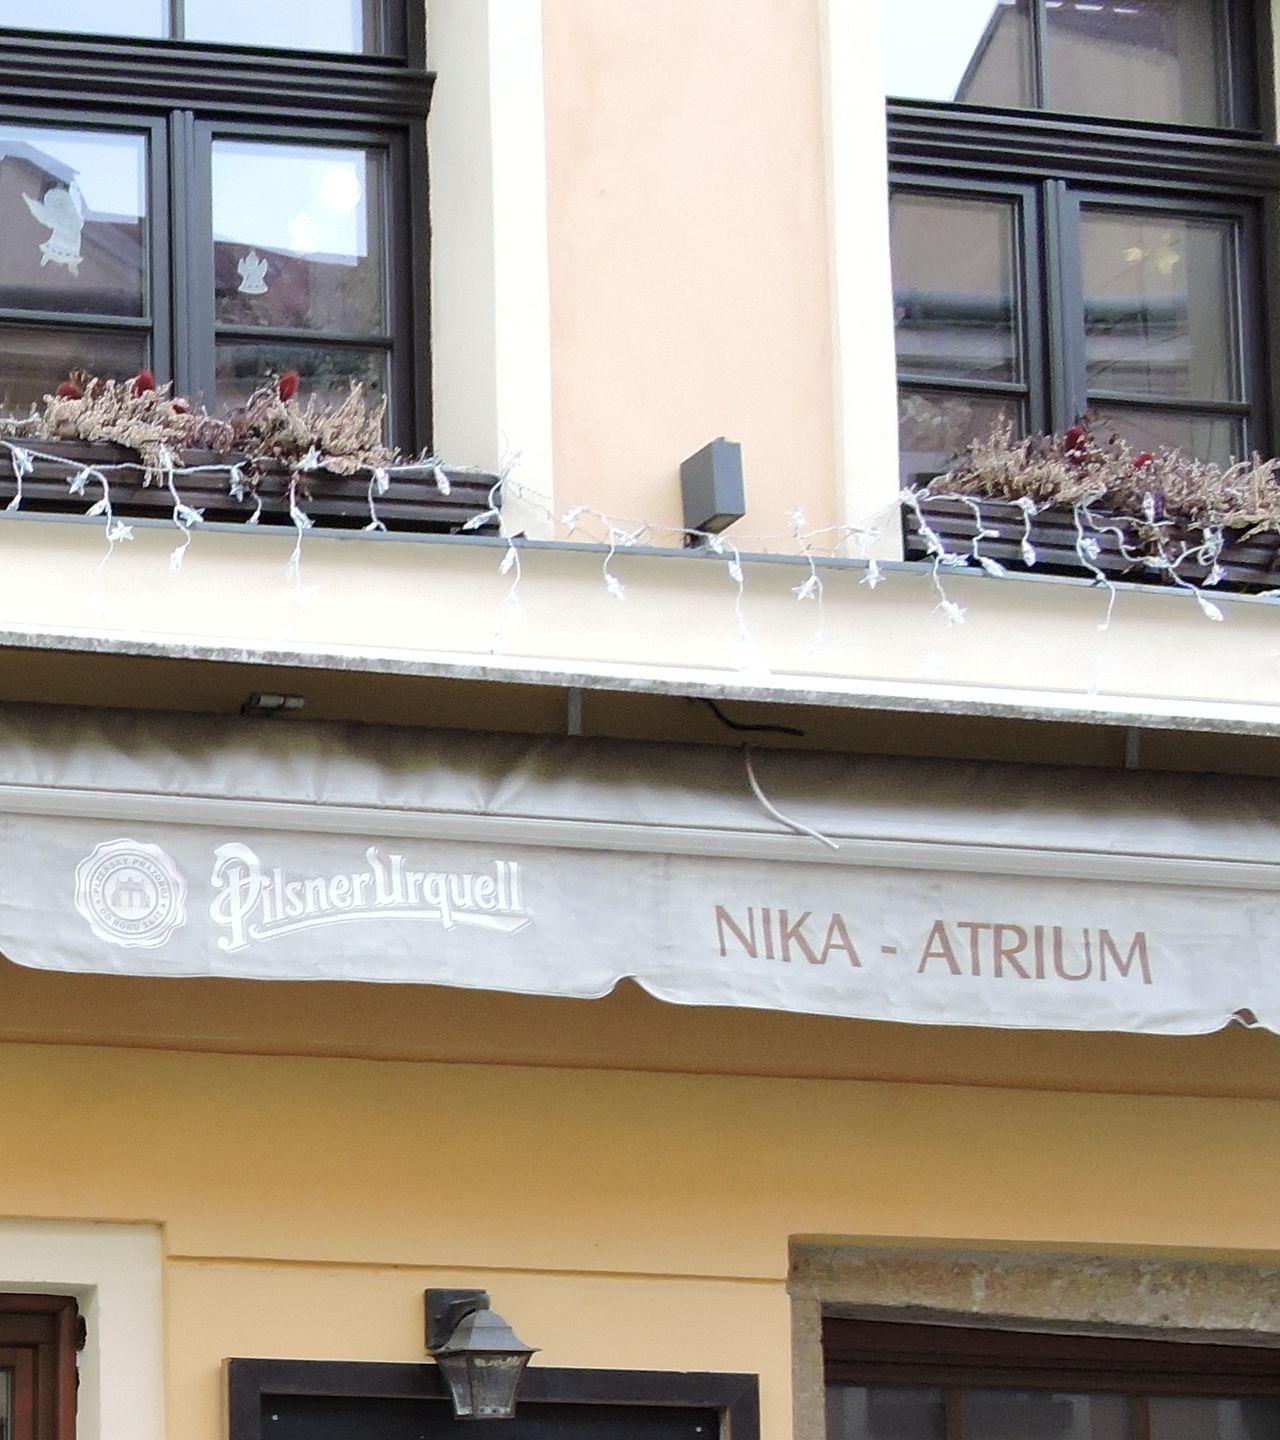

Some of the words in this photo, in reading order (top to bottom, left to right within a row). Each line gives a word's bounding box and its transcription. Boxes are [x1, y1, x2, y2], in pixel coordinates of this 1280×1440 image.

[208, 842, 379, 953] Pilsner
[366, 846, 525, 931] Urquell
[715, 904, 862, 968] NIKA
[880, 945, 897, 954] -
[917, 919, 1153, 985] ATRIUM
